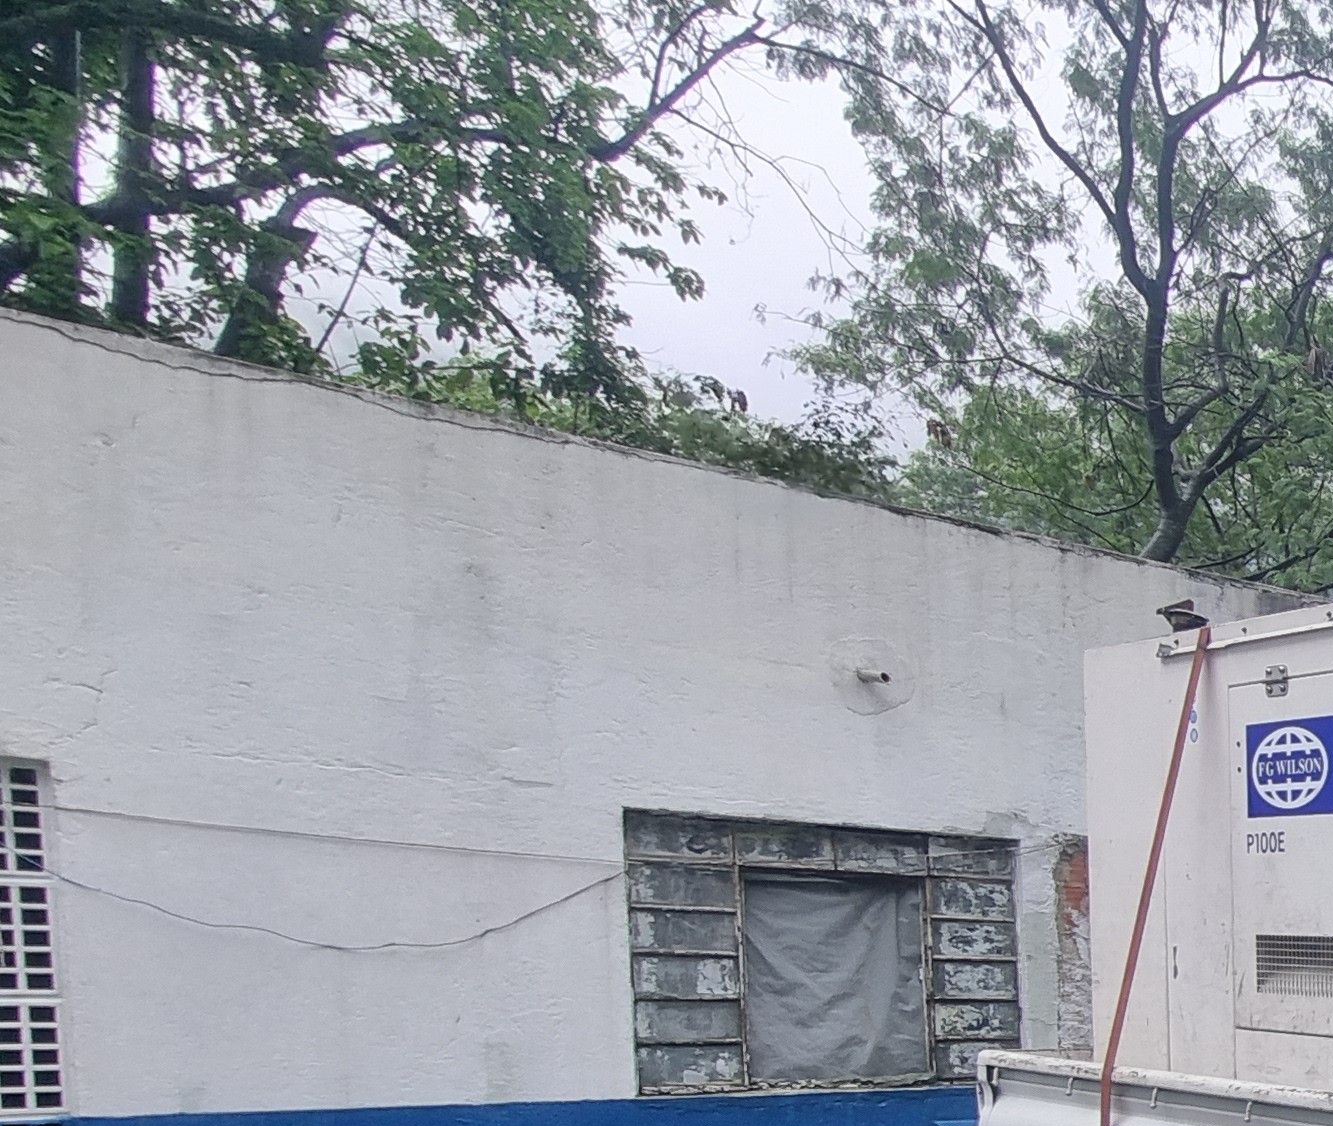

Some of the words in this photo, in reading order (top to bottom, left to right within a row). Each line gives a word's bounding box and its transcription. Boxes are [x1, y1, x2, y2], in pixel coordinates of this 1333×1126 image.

[1258, 760, 1274, 777] FG
[1275, 757, 1322, 776] WILSON
[1246, 831, 1286, 854] P100E
